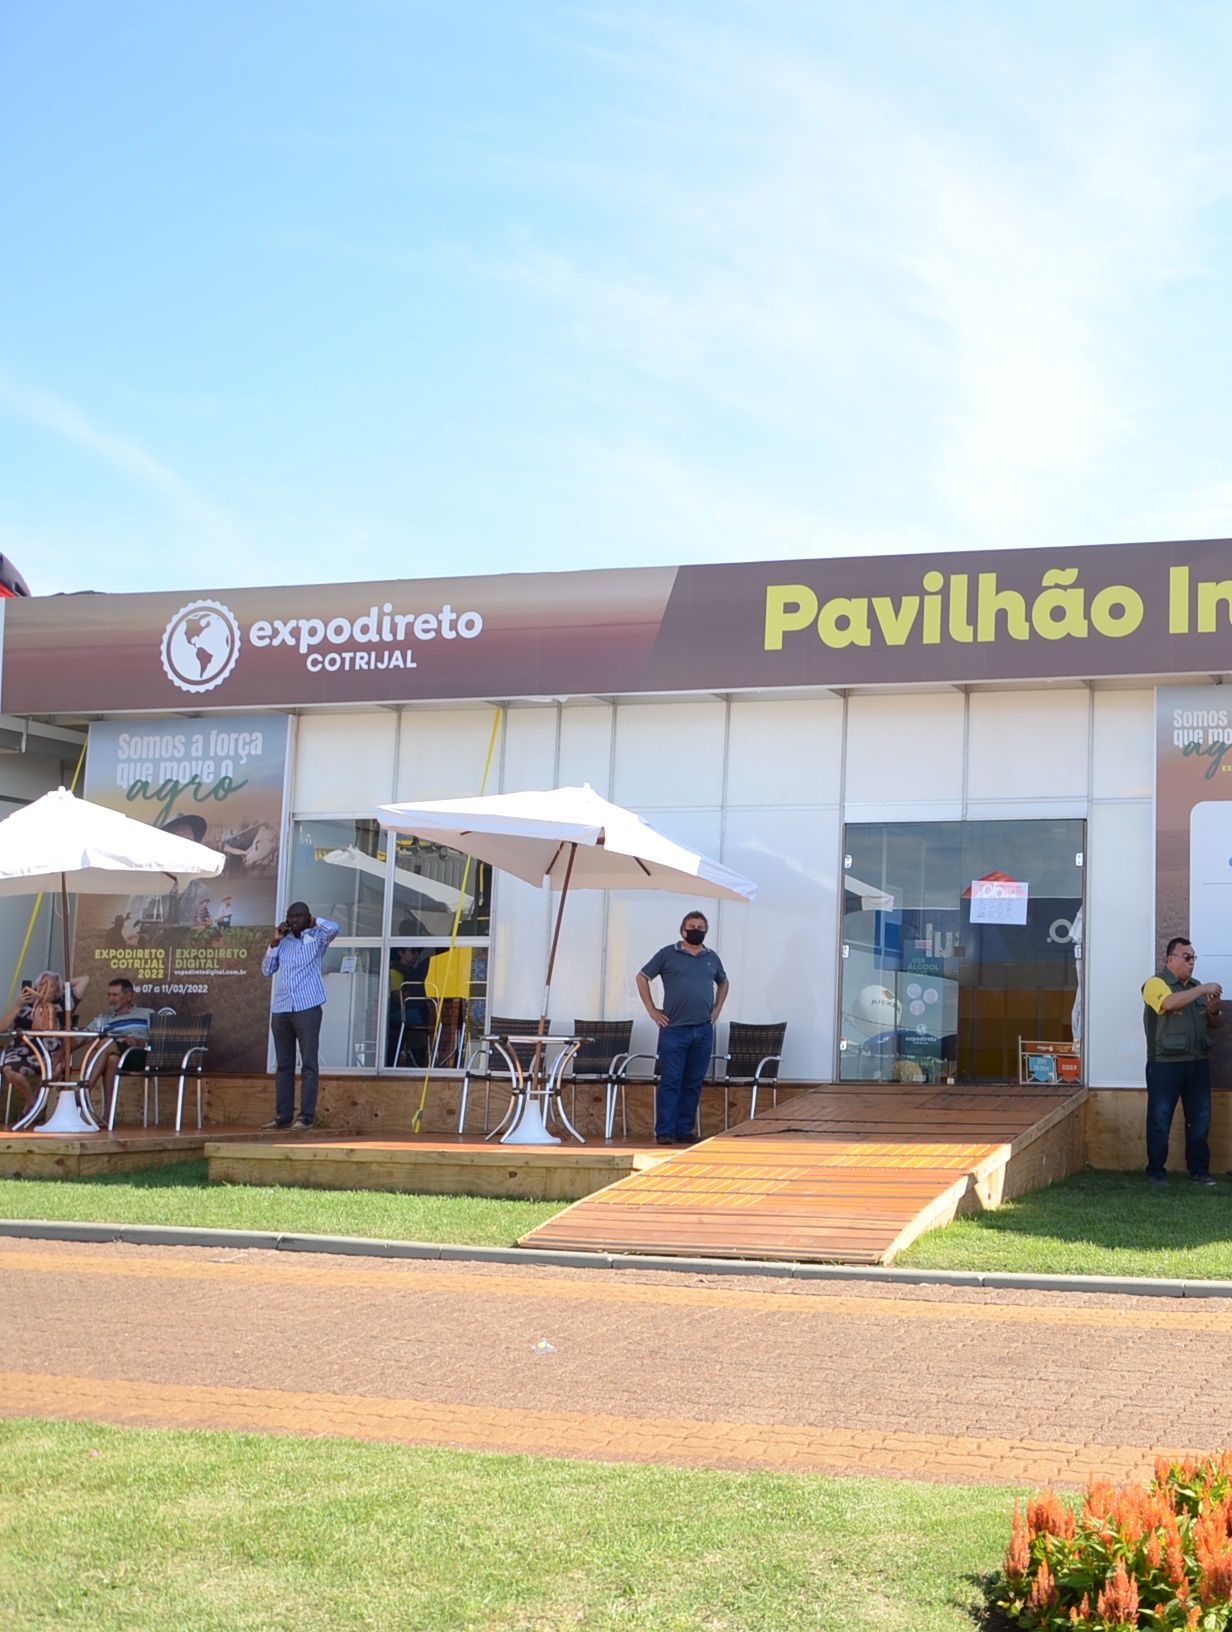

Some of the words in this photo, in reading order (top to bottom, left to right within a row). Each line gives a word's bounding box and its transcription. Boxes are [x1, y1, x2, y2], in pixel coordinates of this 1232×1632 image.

[763, 567, 1145, 651] Pavilhão
[249, 602, 484, 654] expodireto
[306, 650, 418, 673] COTRIJAL
[1173, 709, 1228, 728] Somos
[118, 733, 187, 760] Somos
[190, 734, 204, 758] a
[209, 730, 263, 765] força
[1173, 728, 1204, 748] que
[116, 760, 154, 789] que
[159, 760, 215, 784] move
[220, 759, 234, 784] o
[126, 773, 249, 828] agro
[95, 949, 166, 960] EXPODIRETO
[175, 948, 248, 959] EXPODIRETO
[110, 959, 165, 970] COTRIJAL
[175, 958, 220, 969] DIGITAL
[138, 969, 165, 979] 2022
[142, 984, 153, 994] 07
[153, 985, 160, 993] a
[161, 984, 208, 995] 11/03/2022
